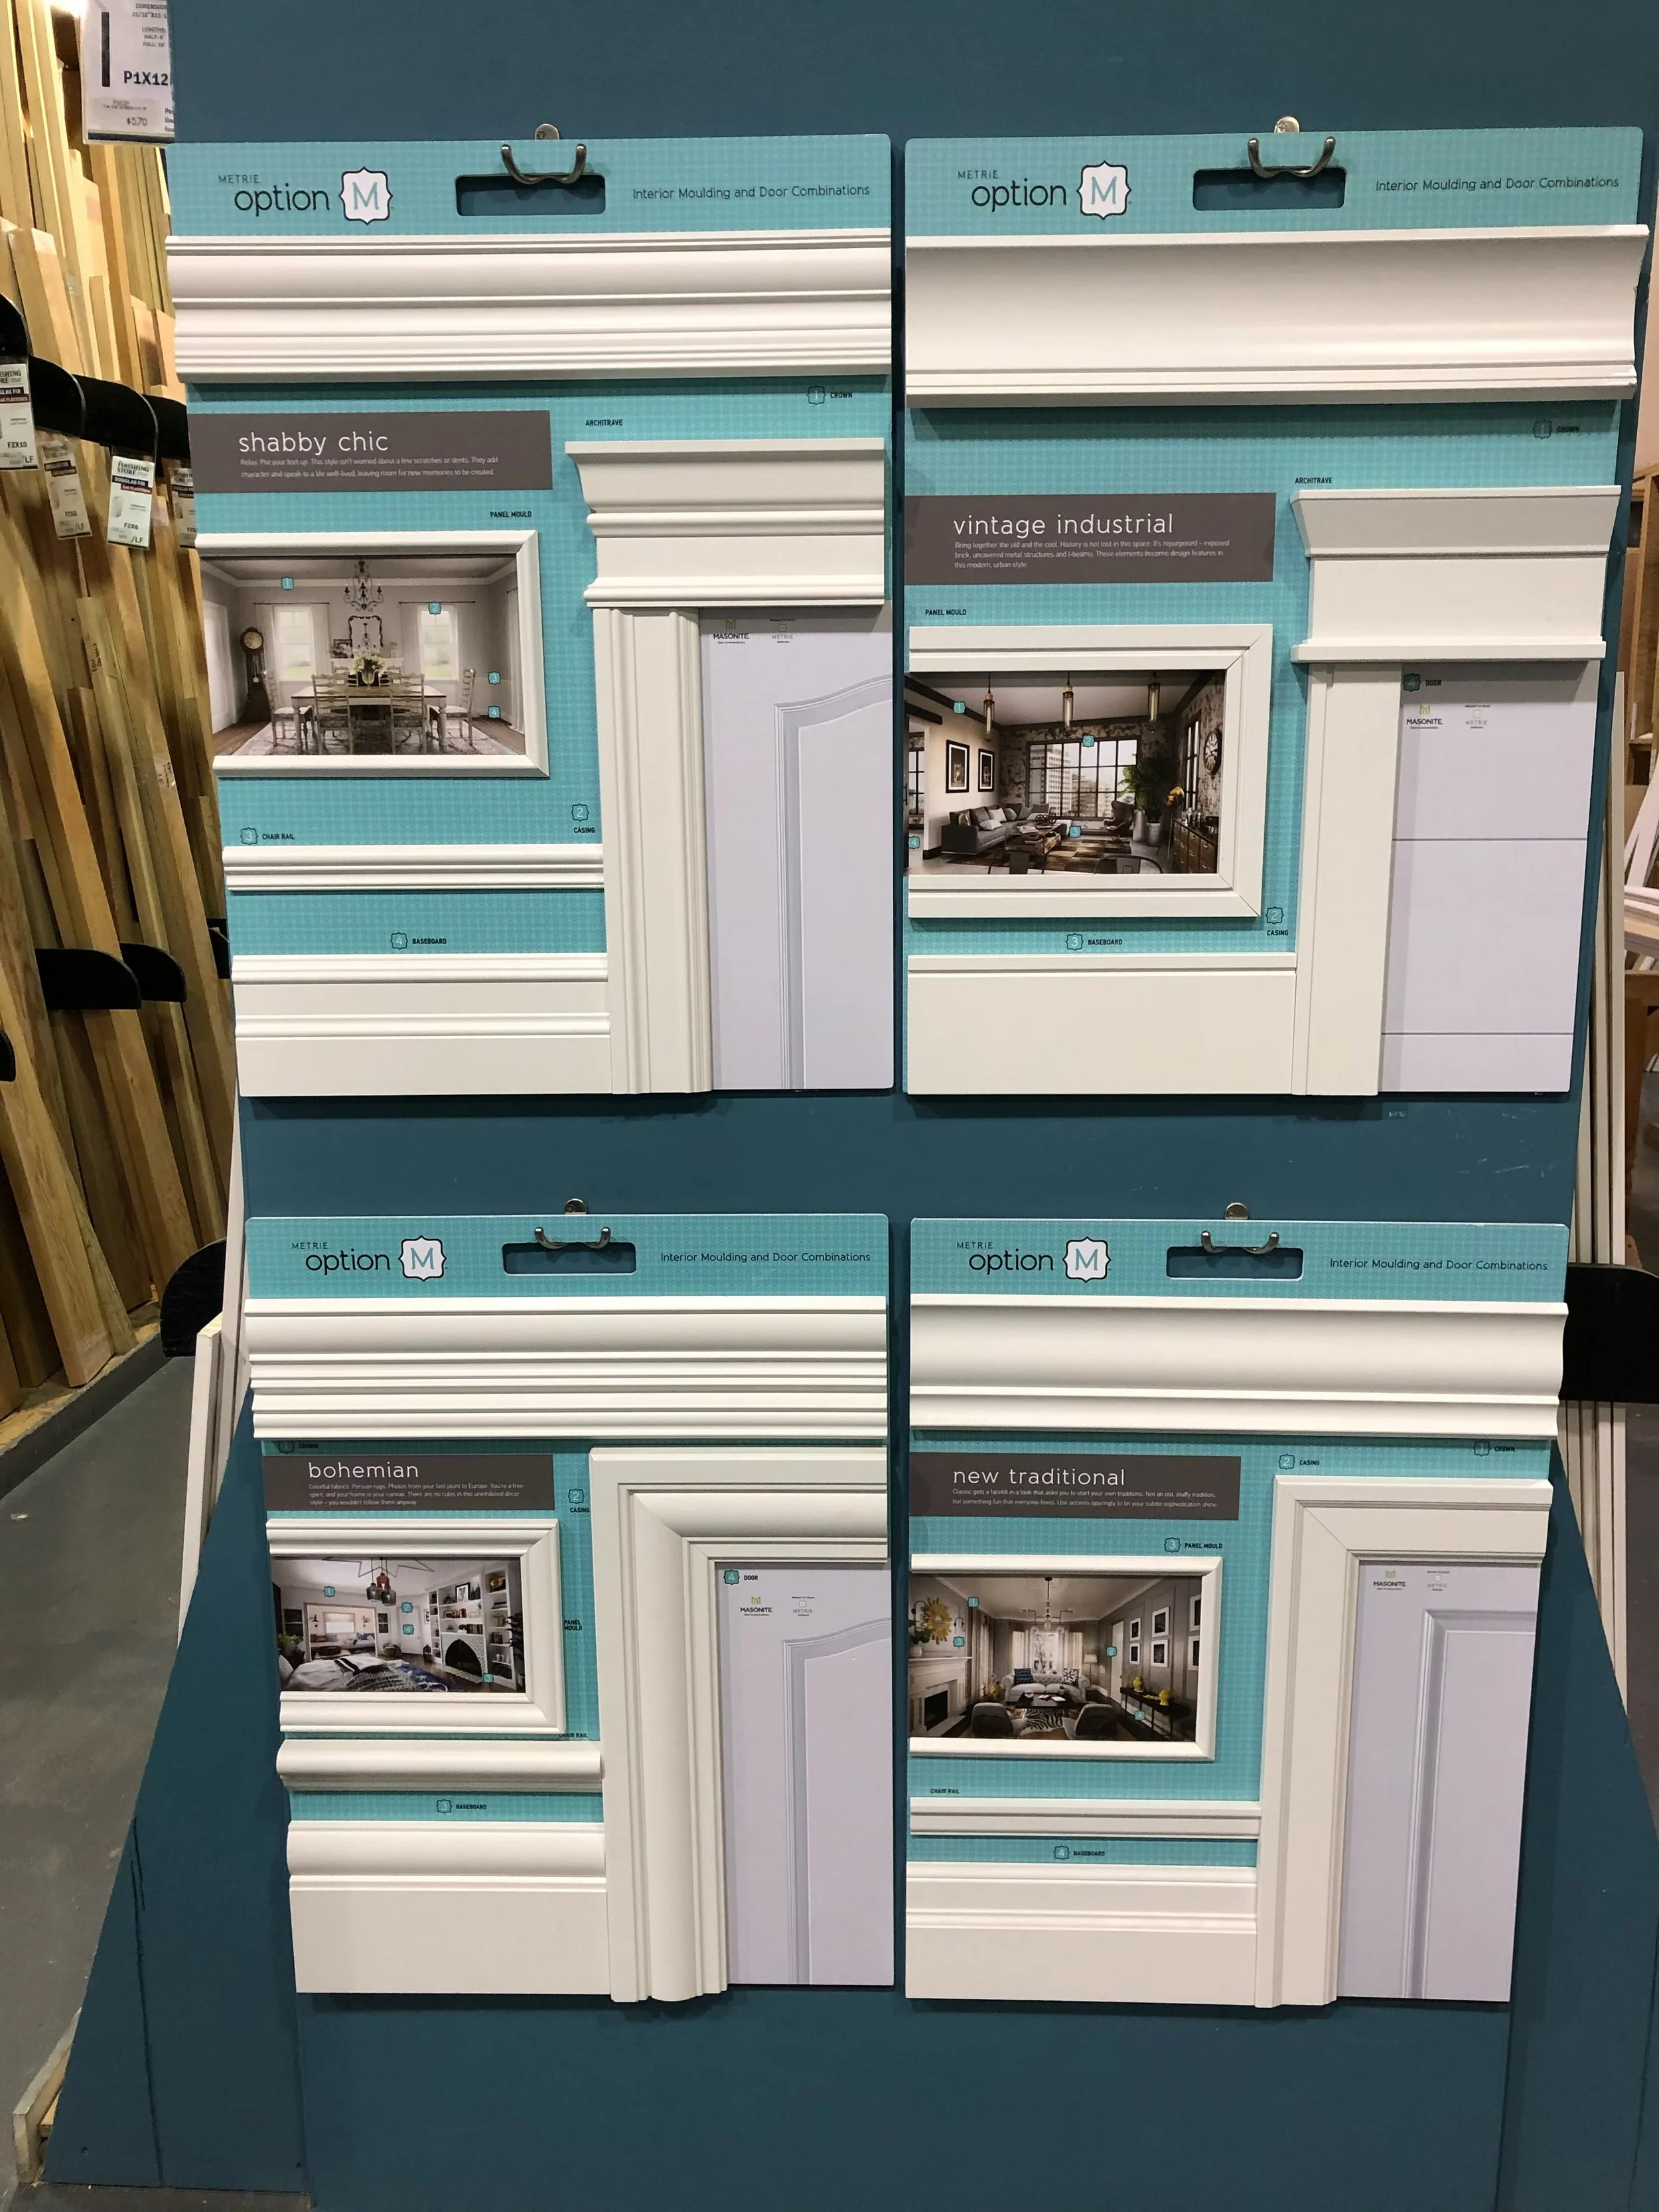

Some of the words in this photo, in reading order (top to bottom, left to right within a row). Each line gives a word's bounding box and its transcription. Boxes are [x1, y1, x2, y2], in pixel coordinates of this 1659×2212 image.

[124, 70, 171, 86] P1X12
[218, 175, 260, 184] METRIE
[958, 170, 998, 179] METRIE
[1376, 181, 1418, 191] Interior
[1423, 179, 1476, 192] Moulding
[1480, 179, 1501, 189] and
[1506, 178, 1535, 188] Door
[1539, 177, 1619, 188] Combinations
[633, 188, 674, 199] Interior
[679, 188, 730, 200] Moulding
[735, 187, 755, 198] and
[760, 186, 788, 197] Door
[792, 185, 869, 196] Combinations
[972, 178, 1066, 212] option
[235, 183, 330, 217] option
[239, 431, 326, 456] shabby
[338, 431, 388, 451] chic
[118, 461, 149, 473] FINISHING
[954, 515, 1046, 538] vintage
[1057, 513, 1173, 534] industrial
[576, 807, 584, 818] 2
[245, 830, 253, 842] 3
[1271, 911, 1278, 921] 2
[395, 936, 403, 946] 4
[1071, 937, 1078, 947] 3
[306, 1248, 391, 1276] option
[662, 1252, 697, 1261] Interior
[701, 1253, 747, 1262] Moulding
[802, 1252, 870, 1261] Combinations
[969, 1248, 1054, 1276] option
[1331, 1258, 1368, 1268] Interior
[1372, 1259, 1419, 1270] Moulding
[1423, 1260, 1443, 1269] and
[1447, 1260, 1473, 1269] Door
[1477, 1261, 1548, 1270] Combinations
[1283, 1457, 1290, 1467] 2
[309, 1461, 418, 1478] bohemian
[954, 1471, 999, 1484] new
[1009, 1467, 1125, 1485] traditional
[573, 1492, 580, 1501] 2
[1169, 1540, 1176, 1549] 3
[728, 1573, 735, 1582] 4
